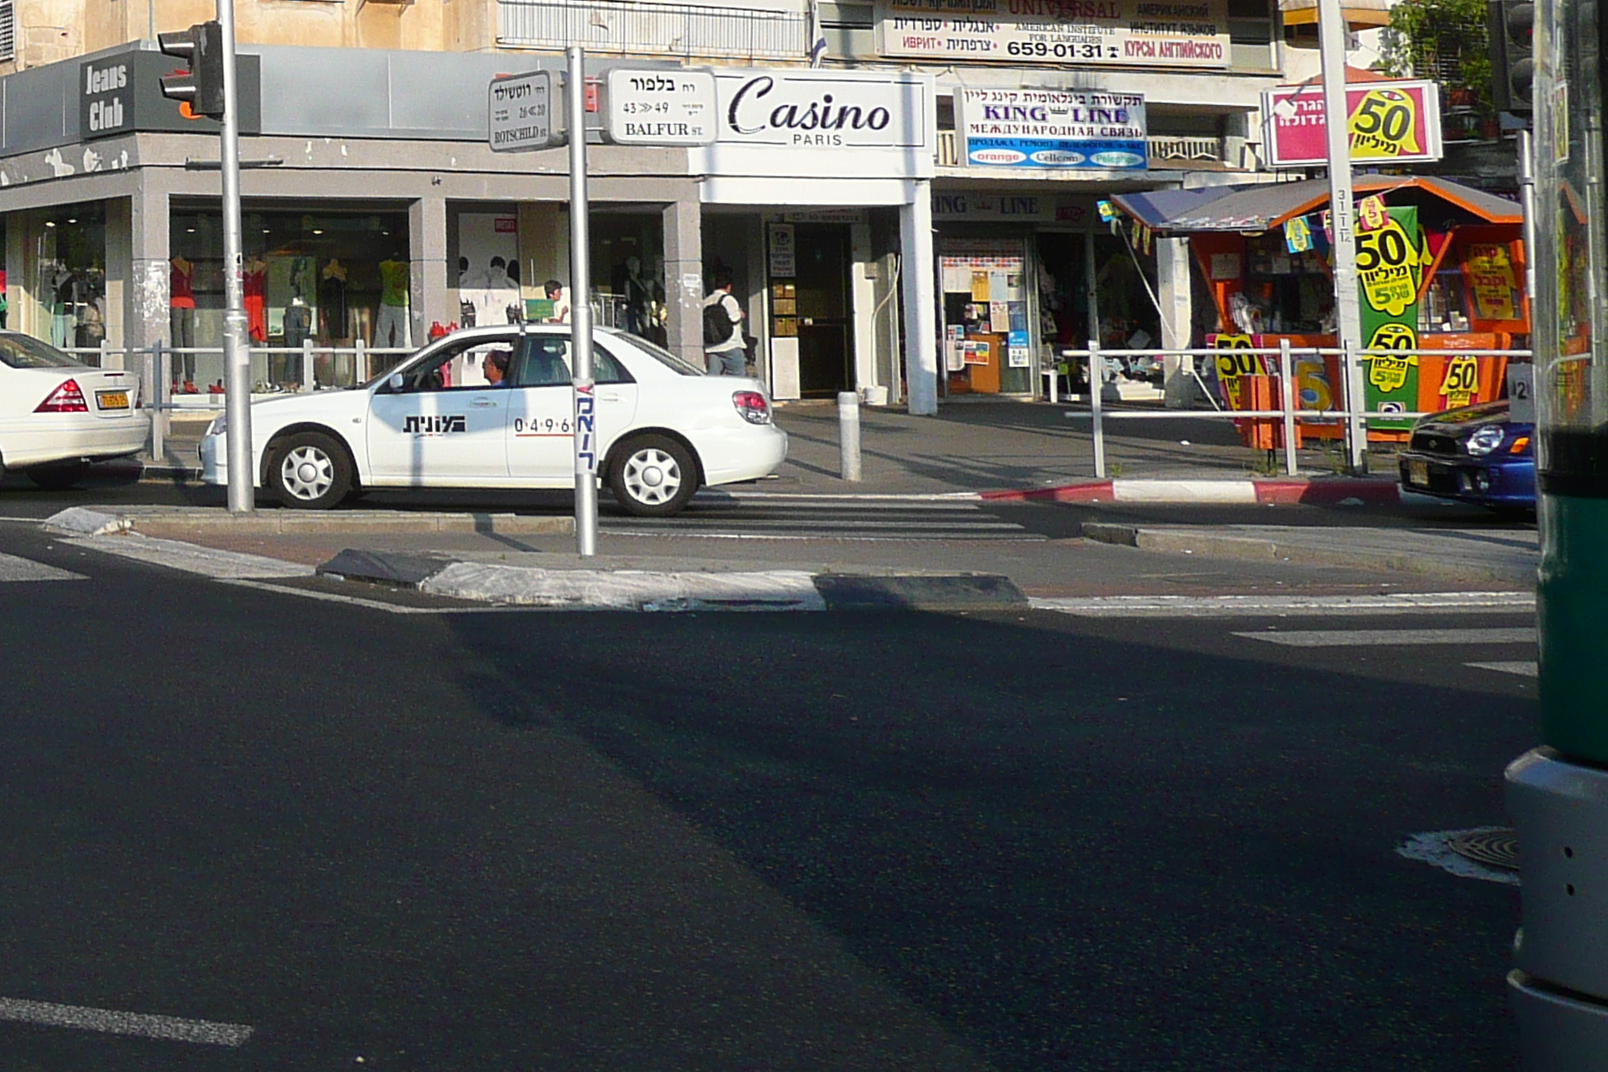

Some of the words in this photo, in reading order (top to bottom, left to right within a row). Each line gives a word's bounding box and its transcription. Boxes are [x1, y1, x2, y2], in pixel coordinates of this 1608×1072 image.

[893, 16, 942, 31] ספרדית
[952, 17, 995, 33] אנגלית
[1015, 23, 1066, 34] AMERICAN
[1067, 25, 1116, 36] INSTITUTE
[1130, 21, 1177, 36] ИНСТИТУТ
[903, 36, 937, 50] ИВРИТ
[946, 38, 992, 52] צרפתית
[1029, 33, 1047, 43] FOR
[1007, 41, 1103, 59] 659-01-31
[1124, 40, 1156, 58] КУРСЫ
[86, 65, 127, 95] Jeans
[630, 74, 675, 92] בלפור
[494, 83, 531, 102] רוטשילד
[964, 89, 988, 103] ליין
[991, 91, 1018, 104] קינג
[1023, 92, 1086, 105] בינלאומית
[1091, 94, 1142, 107] תקשורת
[89, 97, 124, 131] Club
[728, 76, 891, 135] Casino
[984, 105, 1047, 122] KING
[1072, 107, 1130, 124] LINE
[1355, 97, 1411, 141] 50
[494, 126, 539, 144] ROTSCHILD
[625, 123, 689, 136] BALFUR
[970, 123, 1095, 137] МЕЖДУНАРОДНАЯ
[1100, 127, 1143, 138] СВЯЗЬ
[793, 134, 843, 146] PARIS
[1355, 133, 1399, 155] מיליון
[977, 152, 1020, 162] orange
[1036, 152, 1079, 163] Cellcom
[931, 195, 967, 214] ING
[999, 196, 1040, 215] LINE
[1355, 229, 1406, 271] 50
[1364, 265, 1408, 282] מיליון
[1373, 333, 1412, 360] 50
[1217, 339, 1256, 376] 50
[1447, 363, 1476, 390] 50
